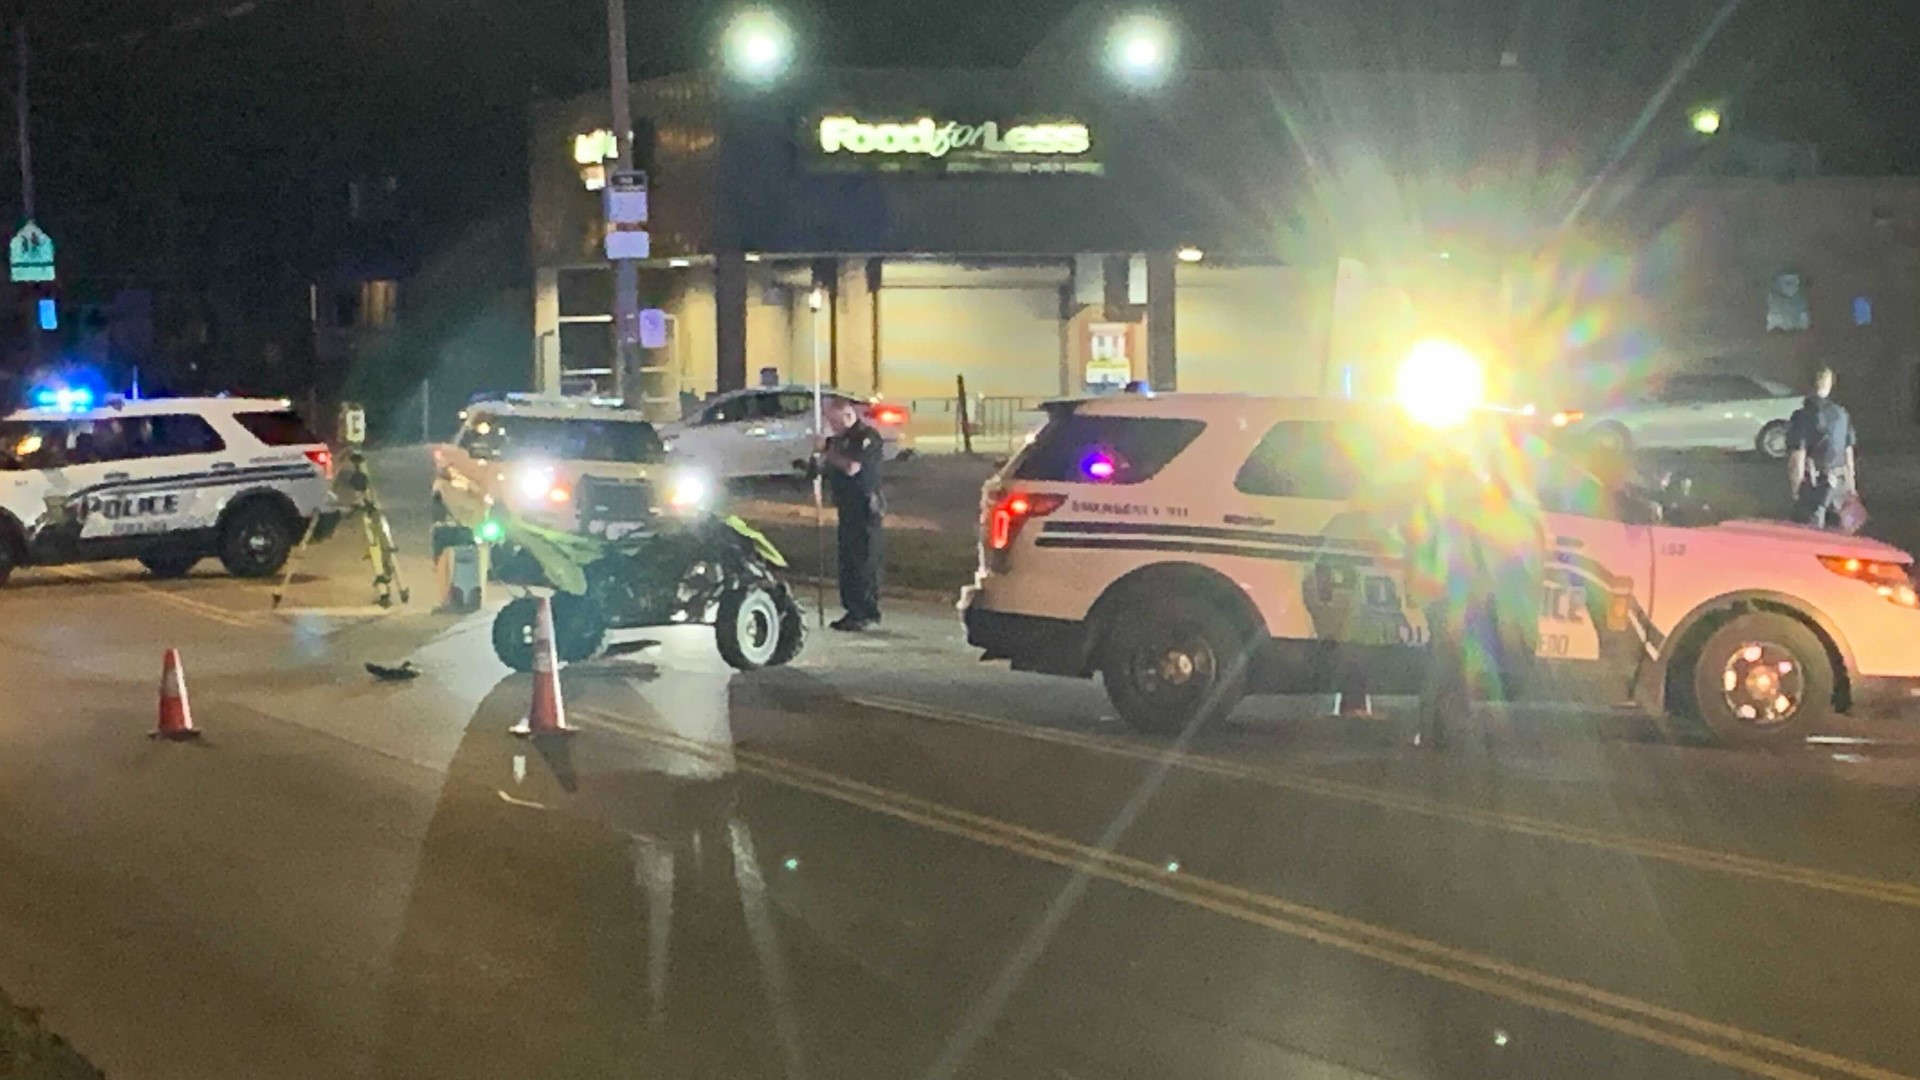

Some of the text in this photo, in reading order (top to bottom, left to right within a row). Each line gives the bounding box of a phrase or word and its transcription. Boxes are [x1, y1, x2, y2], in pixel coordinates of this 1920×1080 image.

[820, 115, 1090, 157] Food for Less
[78, 494, 179, 519] POLICE
